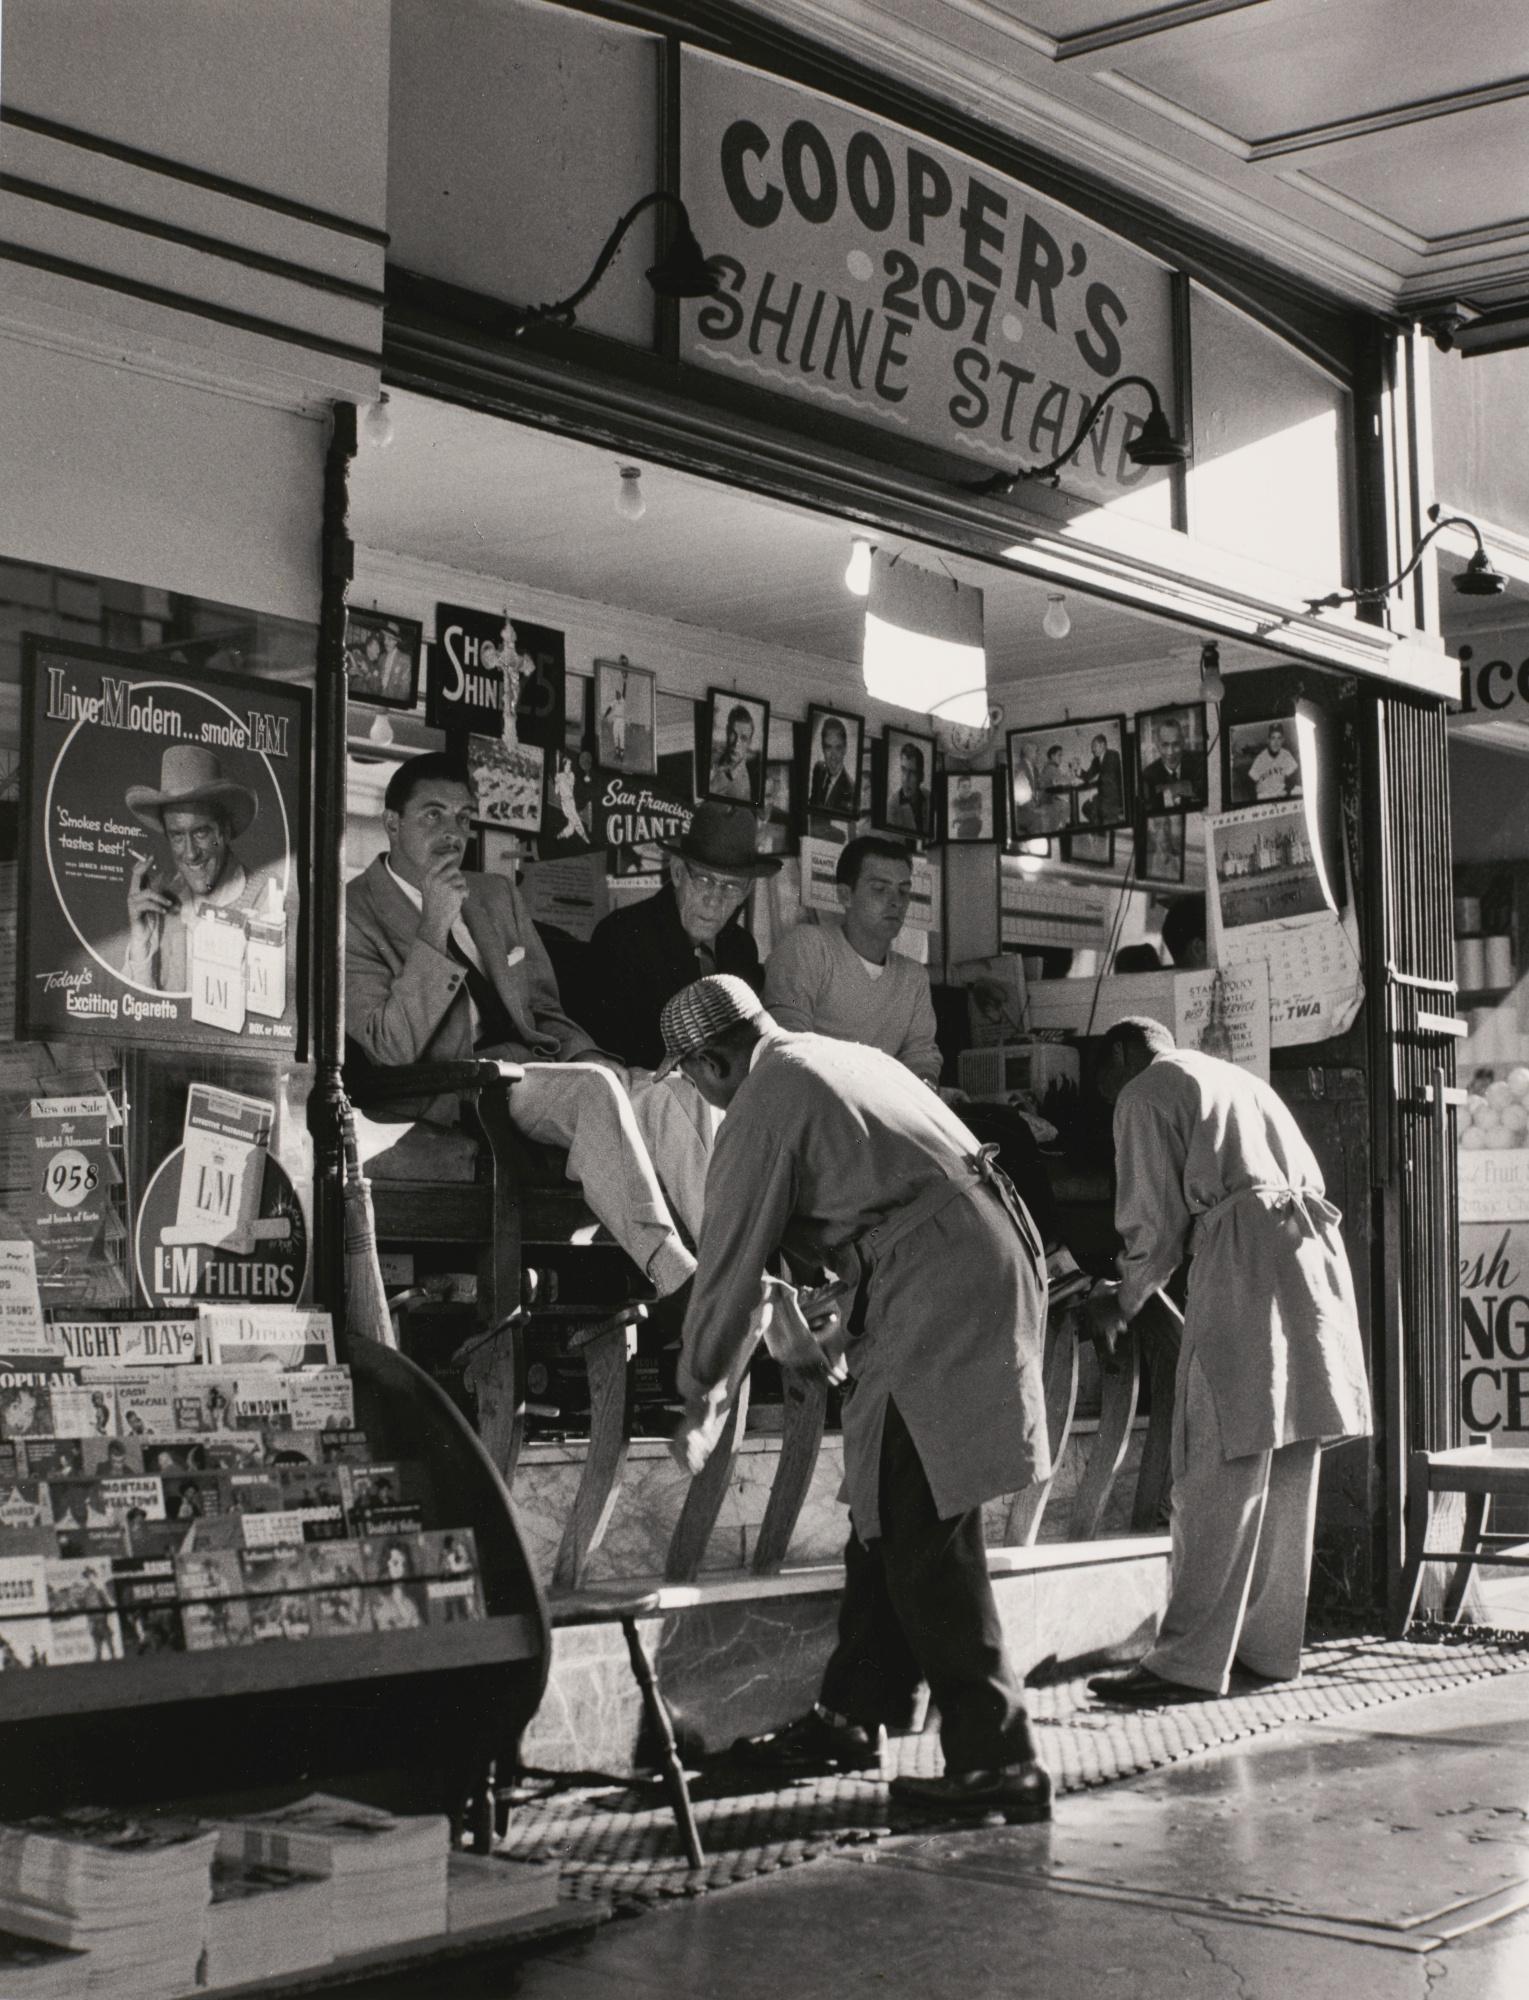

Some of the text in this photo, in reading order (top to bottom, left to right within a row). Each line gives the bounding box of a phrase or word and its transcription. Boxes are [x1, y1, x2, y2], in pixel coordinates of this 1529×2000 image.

[721, 120, 1128, 377] COOPER'S
[883, 249, 998, 345] 207
[698, 254, 914, 402] SHINE
[47, 667, 99, 724] Live
[247, 711, 289, 757] L&M
[602, 779, 694, 820] San Francisco
[58, 833, 95, 852] tastes
[606, 814, 692, 844] GIANTS
[36, 967, 93, 993] Today's
[66, 989, 178, 1021] Exciting Cigarette
[1287, 1001, 1321, 1020] TWA
[36, 1101, 103, 1113] Now on Sale
[35, 1137, 62, 1149] World
[41, 1165, 99, 1194] 1958
[155, 1246, 294, 1298] L&M FILTERS
[60, 1326, 121, 1357] NIGHT
[144, 1325, 187, 1355] DAY
[235, 1400, 289, 1414] LOWDOWN
